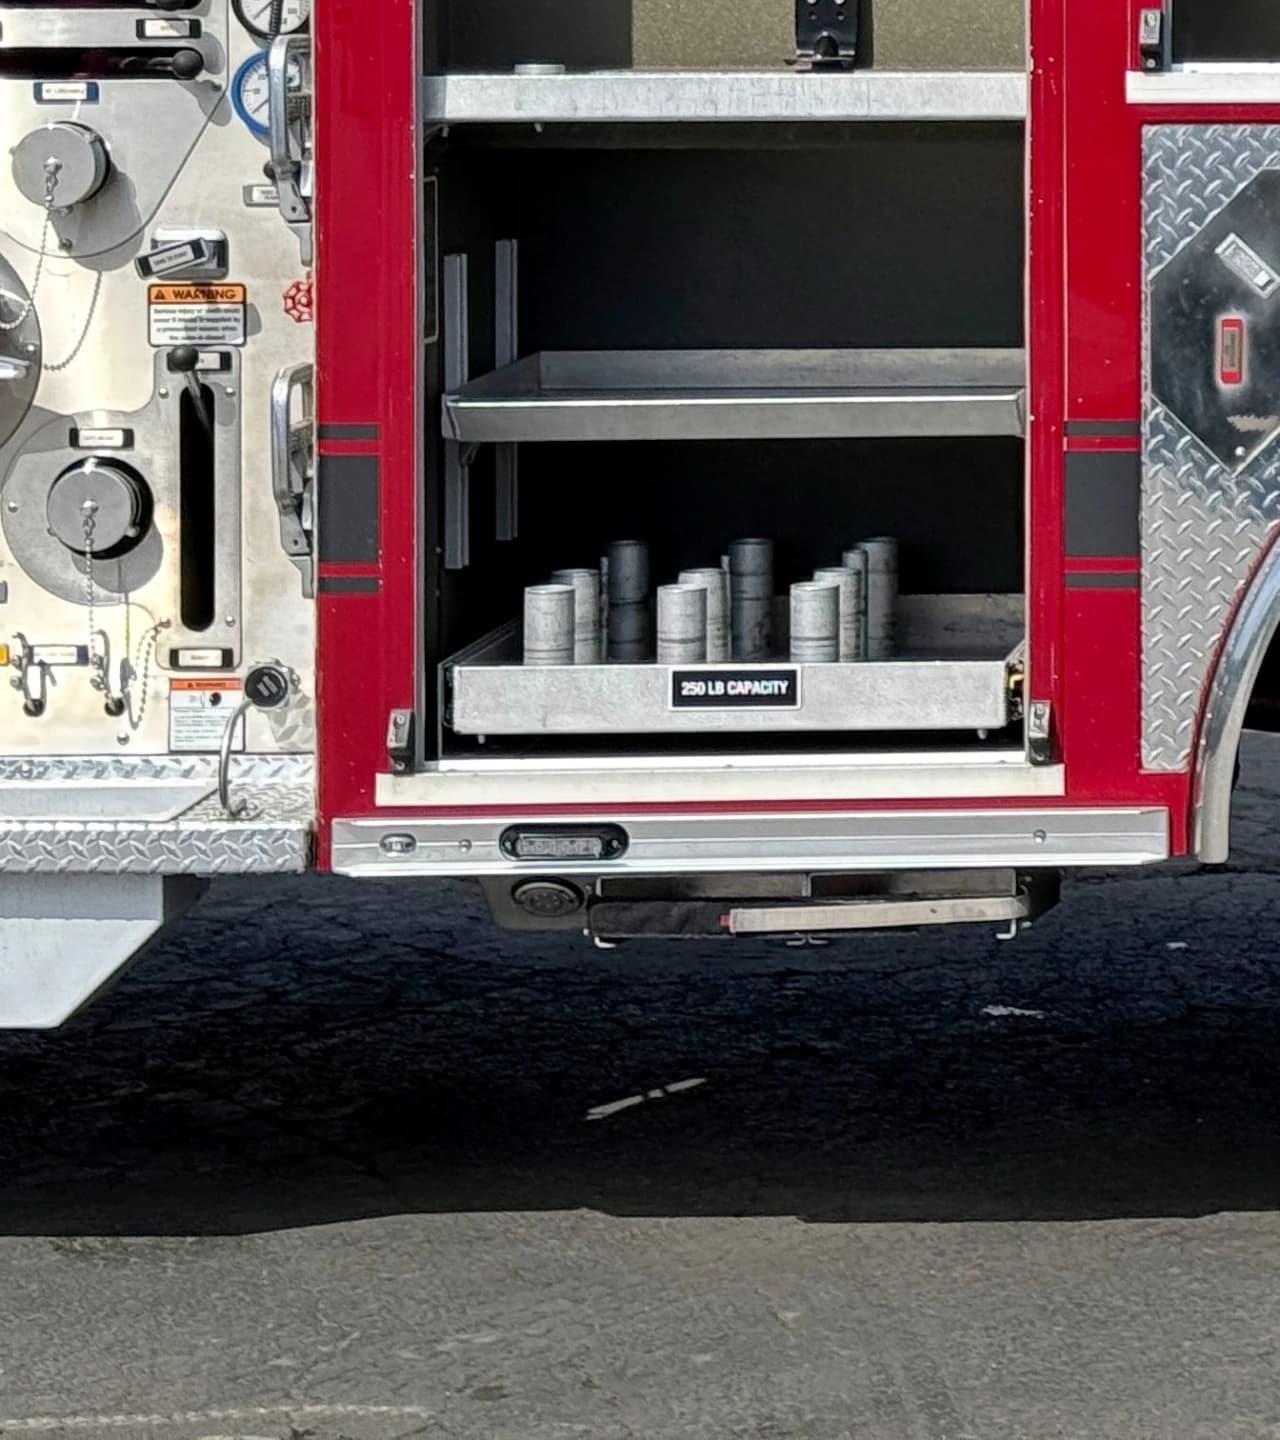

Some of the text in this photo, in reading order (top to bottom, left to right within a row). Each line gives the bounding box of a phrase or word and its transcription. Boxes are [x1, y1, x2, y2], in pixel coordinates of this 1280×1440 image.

[171, 288, 237, 300] WARNING
[680, 680, 790, 696] 250 LB CAPACITY
